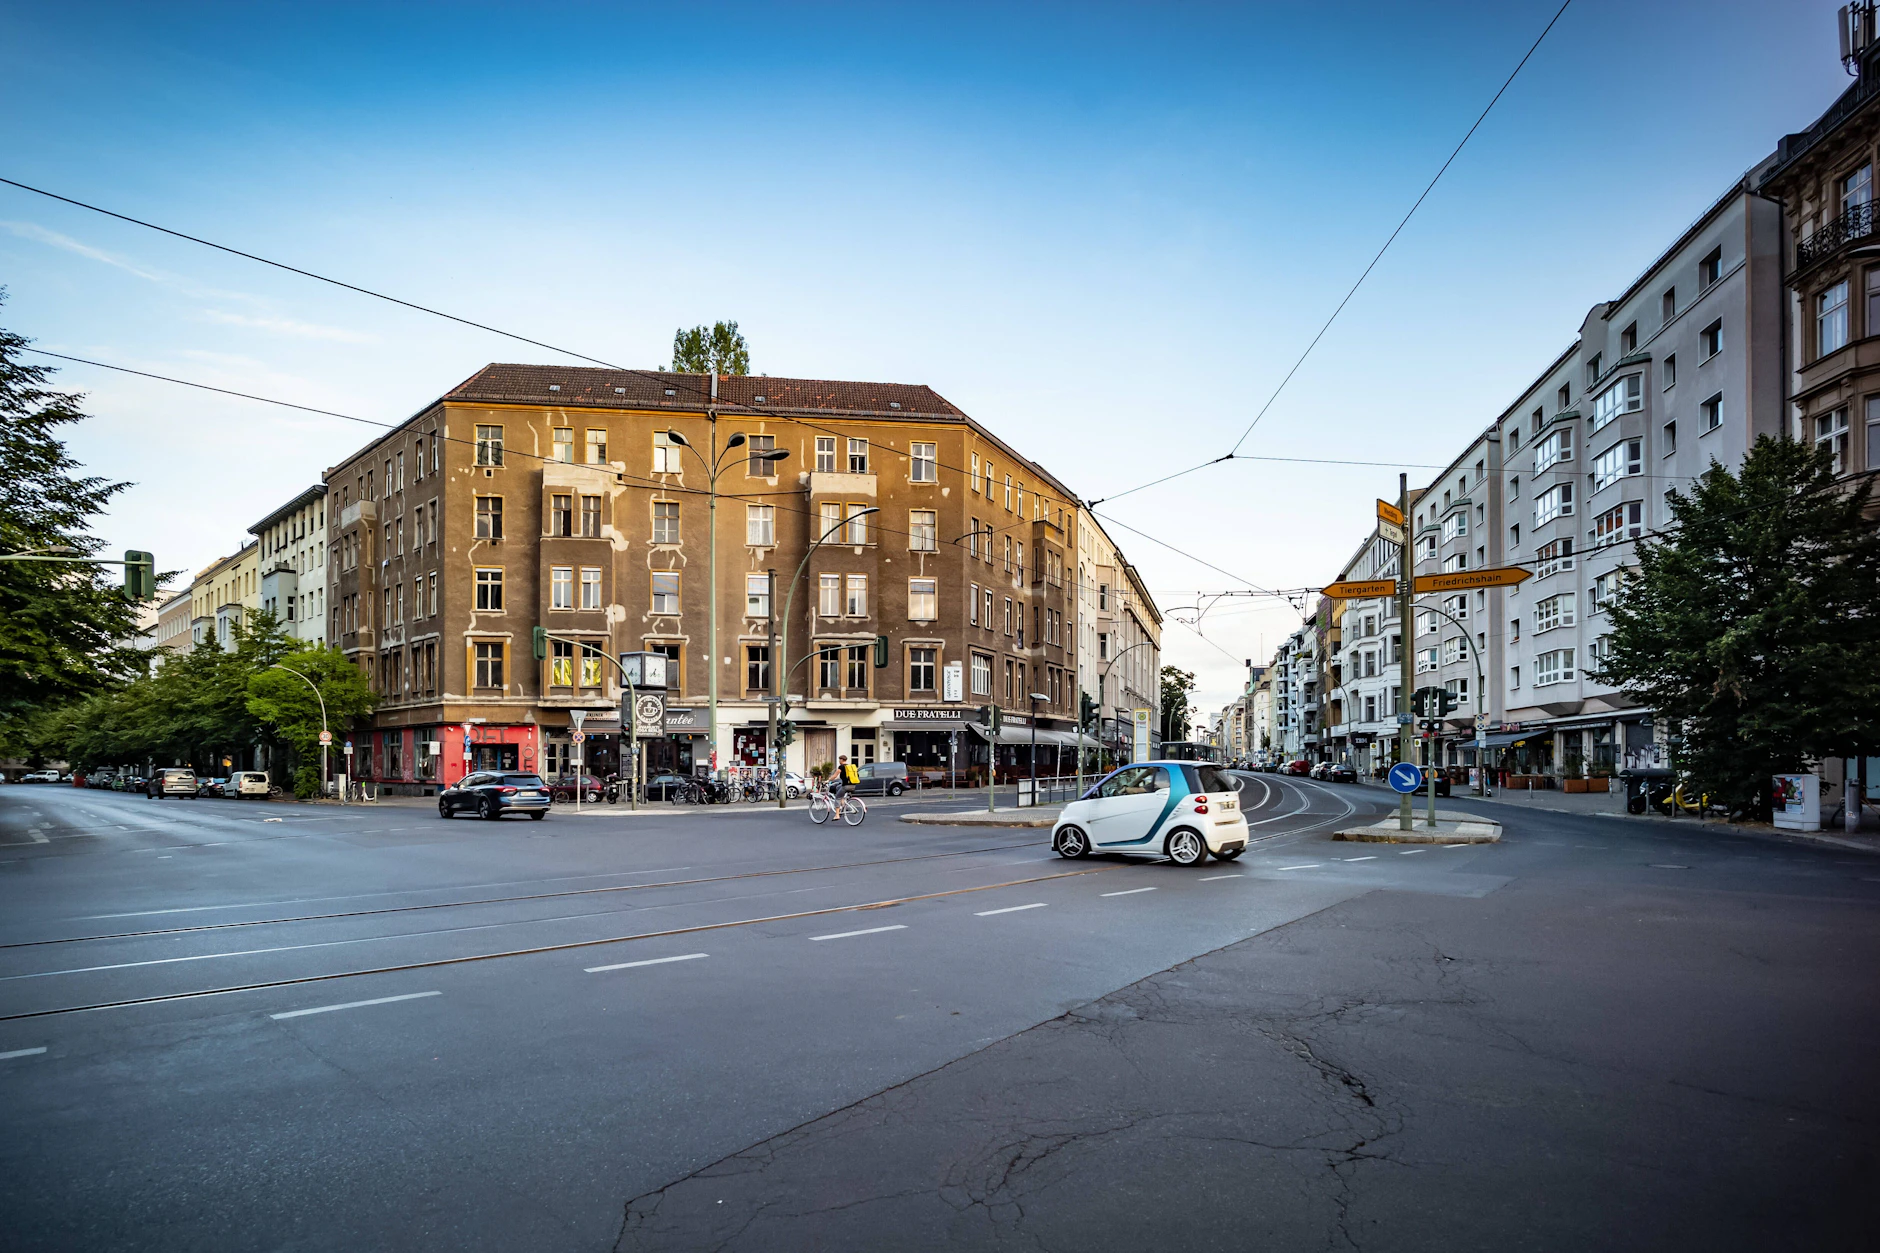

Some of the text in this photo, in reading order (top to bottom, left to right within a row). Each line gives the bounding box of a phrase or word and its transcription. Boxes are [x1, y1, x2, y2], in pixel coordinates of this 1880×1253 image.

[1432, 574, 1502, 587] Friedrichshain
[1339, 585, 1386, 595] Tiergarten
[895, 710, 961, 719] DUE FRATELLI
